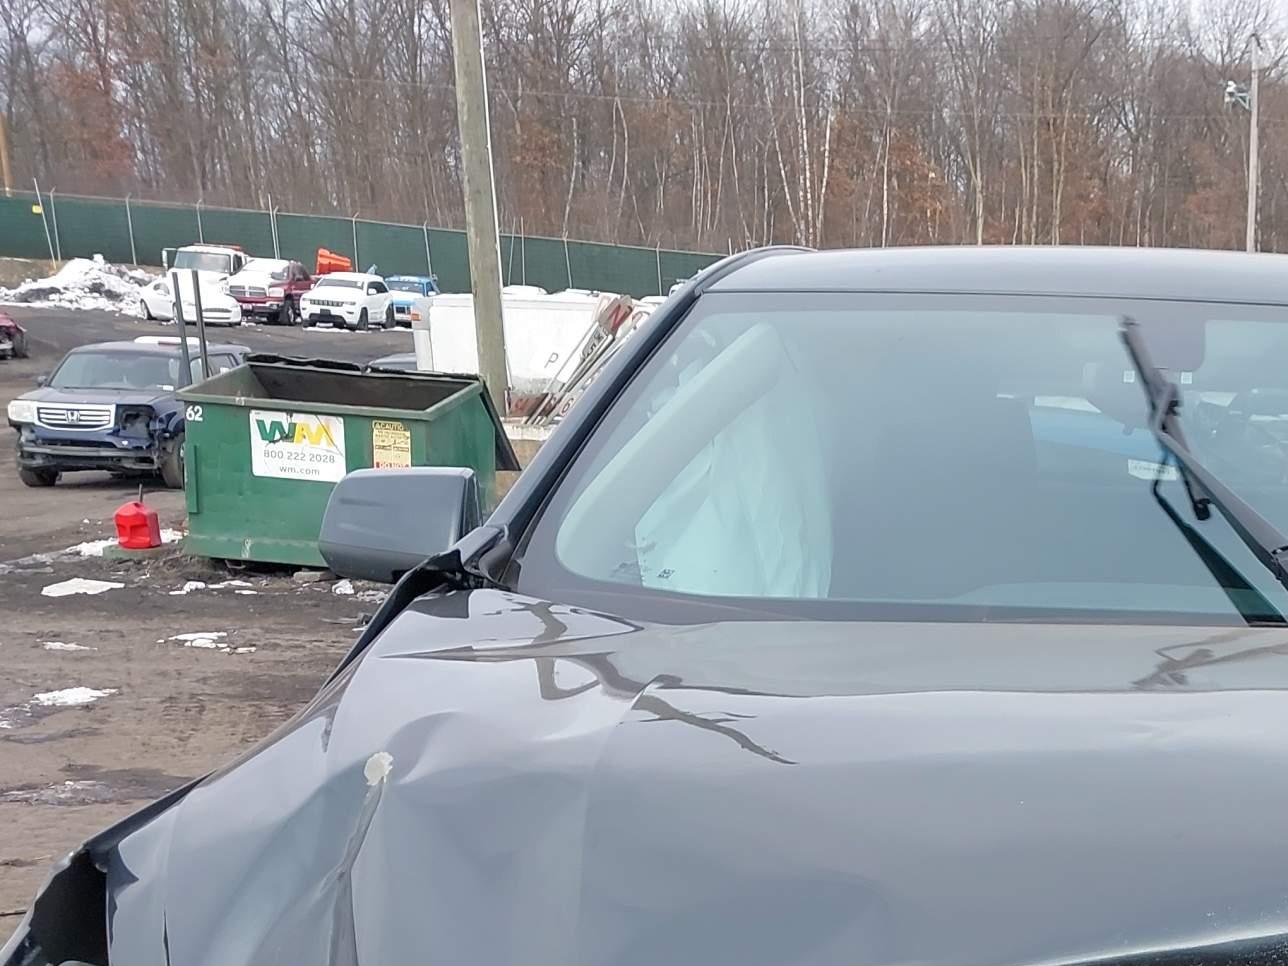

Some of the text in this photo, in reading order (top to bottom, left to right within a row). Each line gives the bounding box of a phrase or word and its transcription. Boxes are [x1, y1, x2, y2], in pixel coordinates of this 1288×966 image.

[185, 405, 203, 421] 62
[263, 449, 335, 464] 800 222 2028
[279, 466, 320, 476] wm.com
